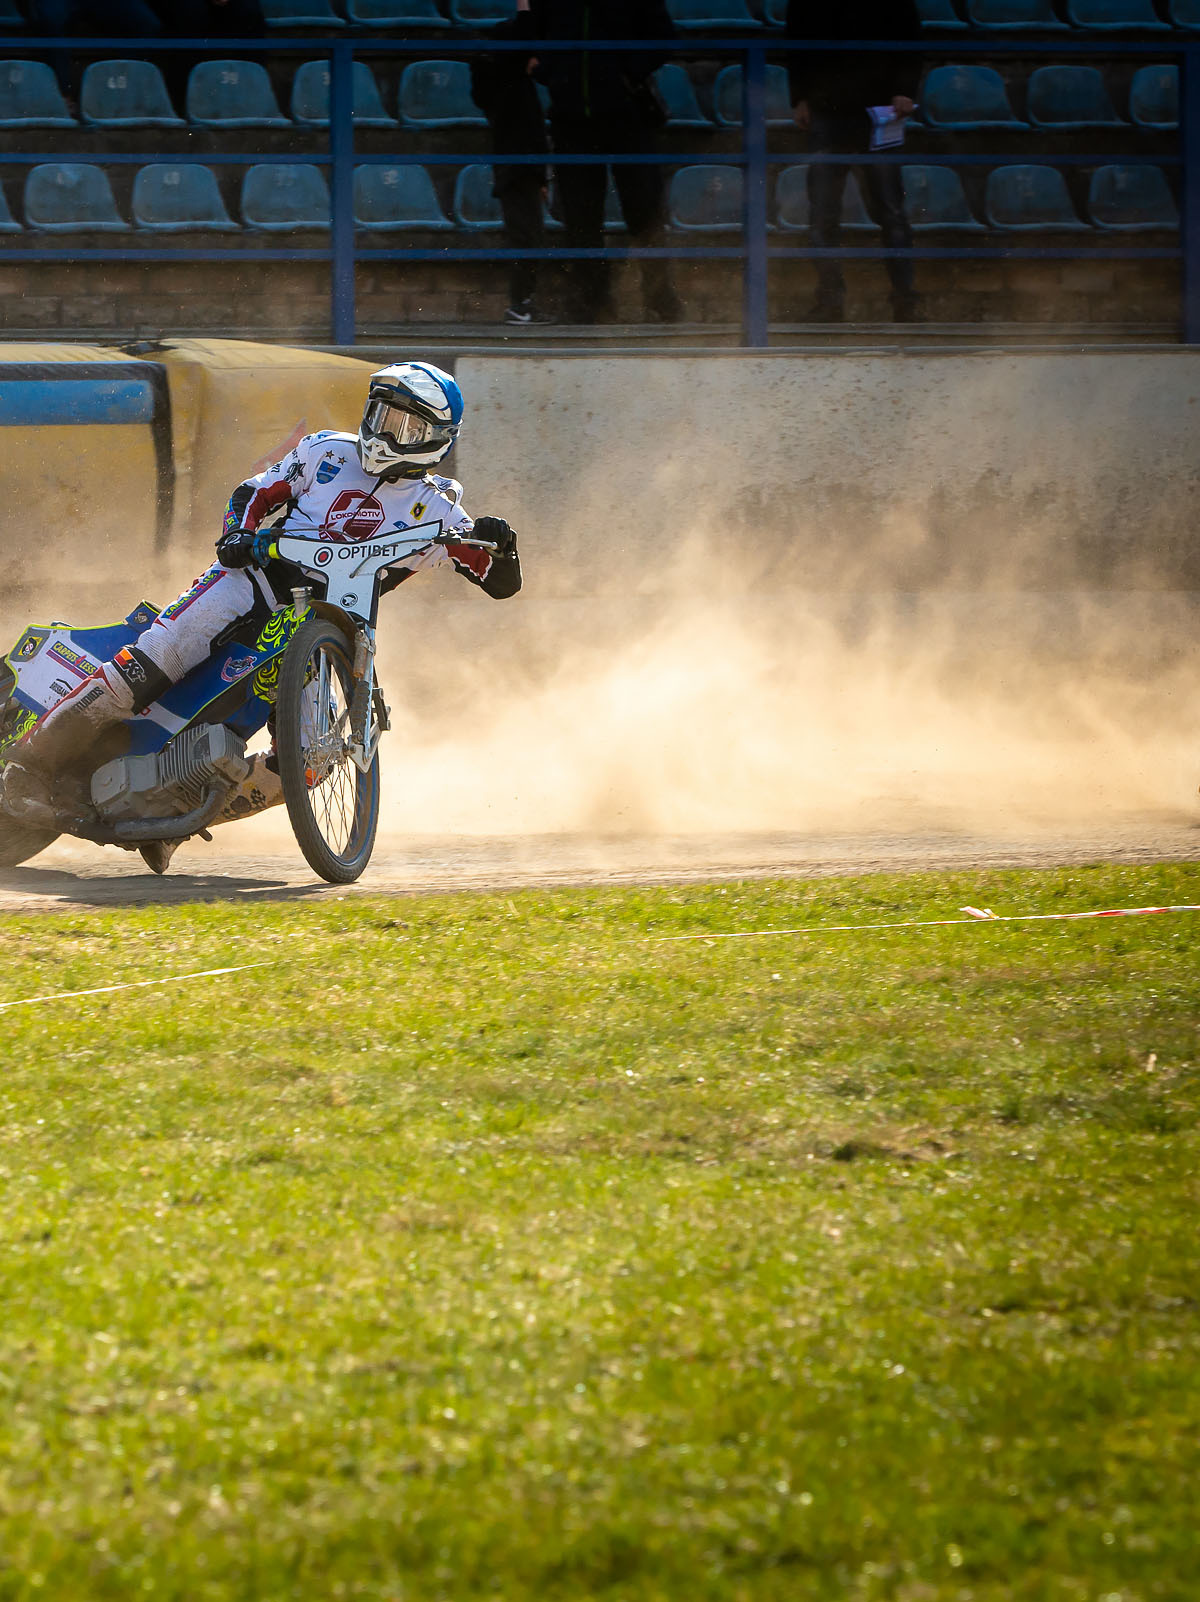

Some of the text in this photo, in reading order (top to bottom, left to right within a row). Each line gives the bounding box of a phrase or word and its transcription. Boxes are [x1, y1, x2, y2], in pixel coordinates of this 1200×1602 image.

[337, 544, 399, 560] OPTIBET
[53, 642, 79, 663] CARPETS
[79, 660, 97, 676] LESS
